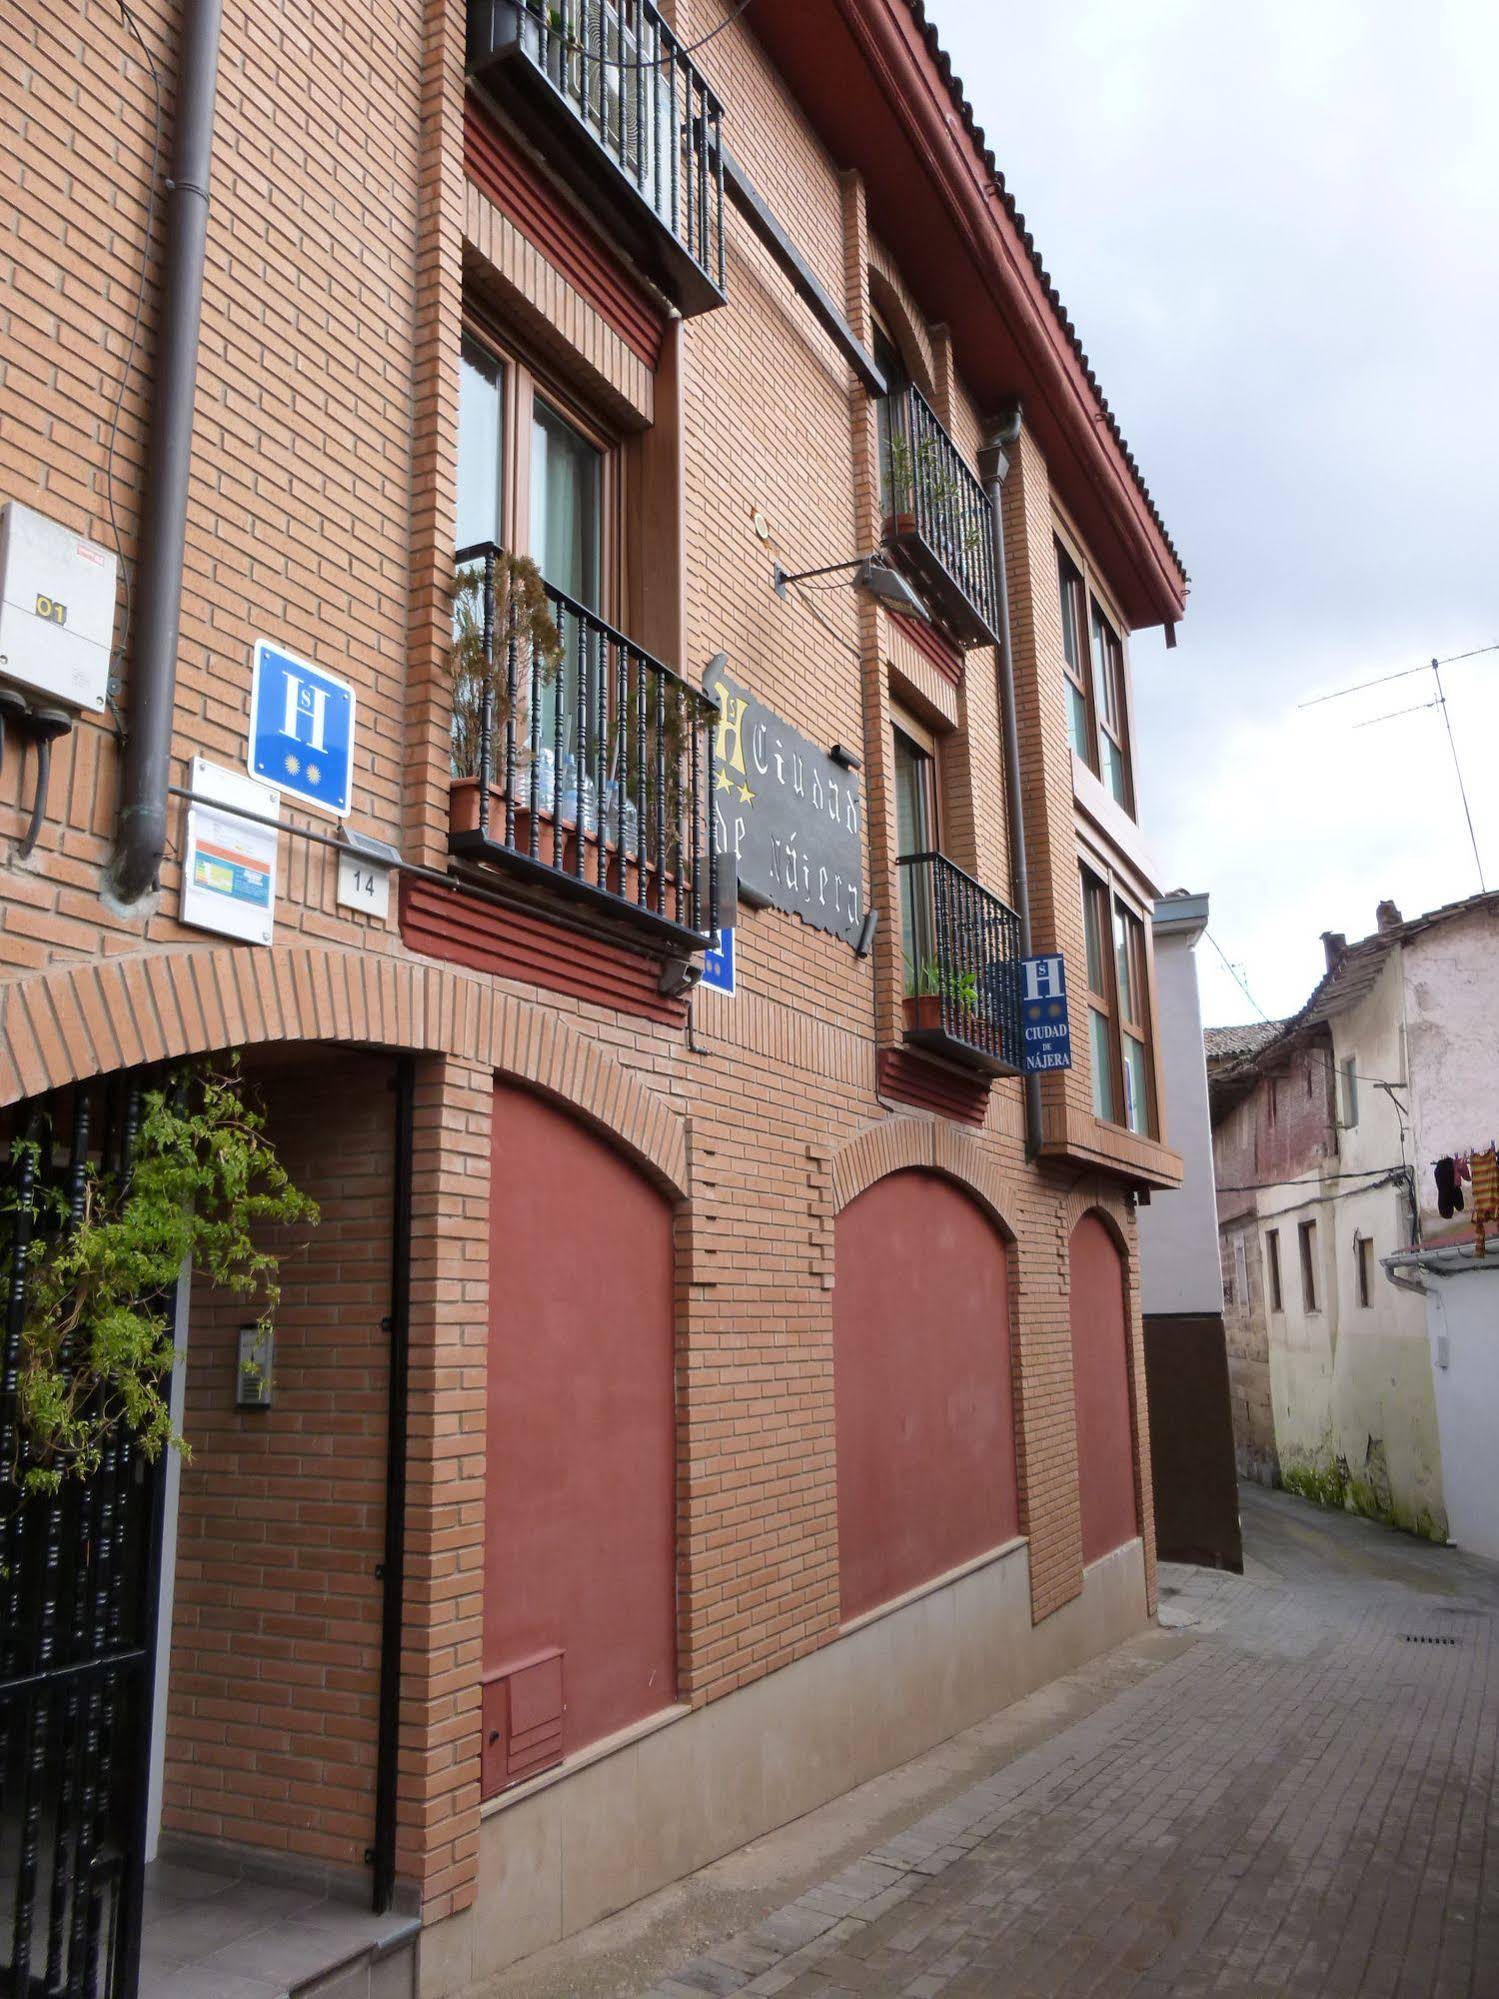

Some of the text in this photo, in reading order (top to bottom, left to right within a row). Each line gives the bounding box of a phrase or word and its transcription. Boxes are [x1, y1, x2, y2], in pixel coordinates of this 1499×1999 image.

[36, 596, 64, 623] 01
[752, 724, 858, 834] Ciudad
[354, 870, 375, 897] 14
[1025, 1023, 1068, 1040] CIUDAD
[1042, 1042, 1052, 1051] DE
[1026, 1052, 1070, 1069] NÁJERA
